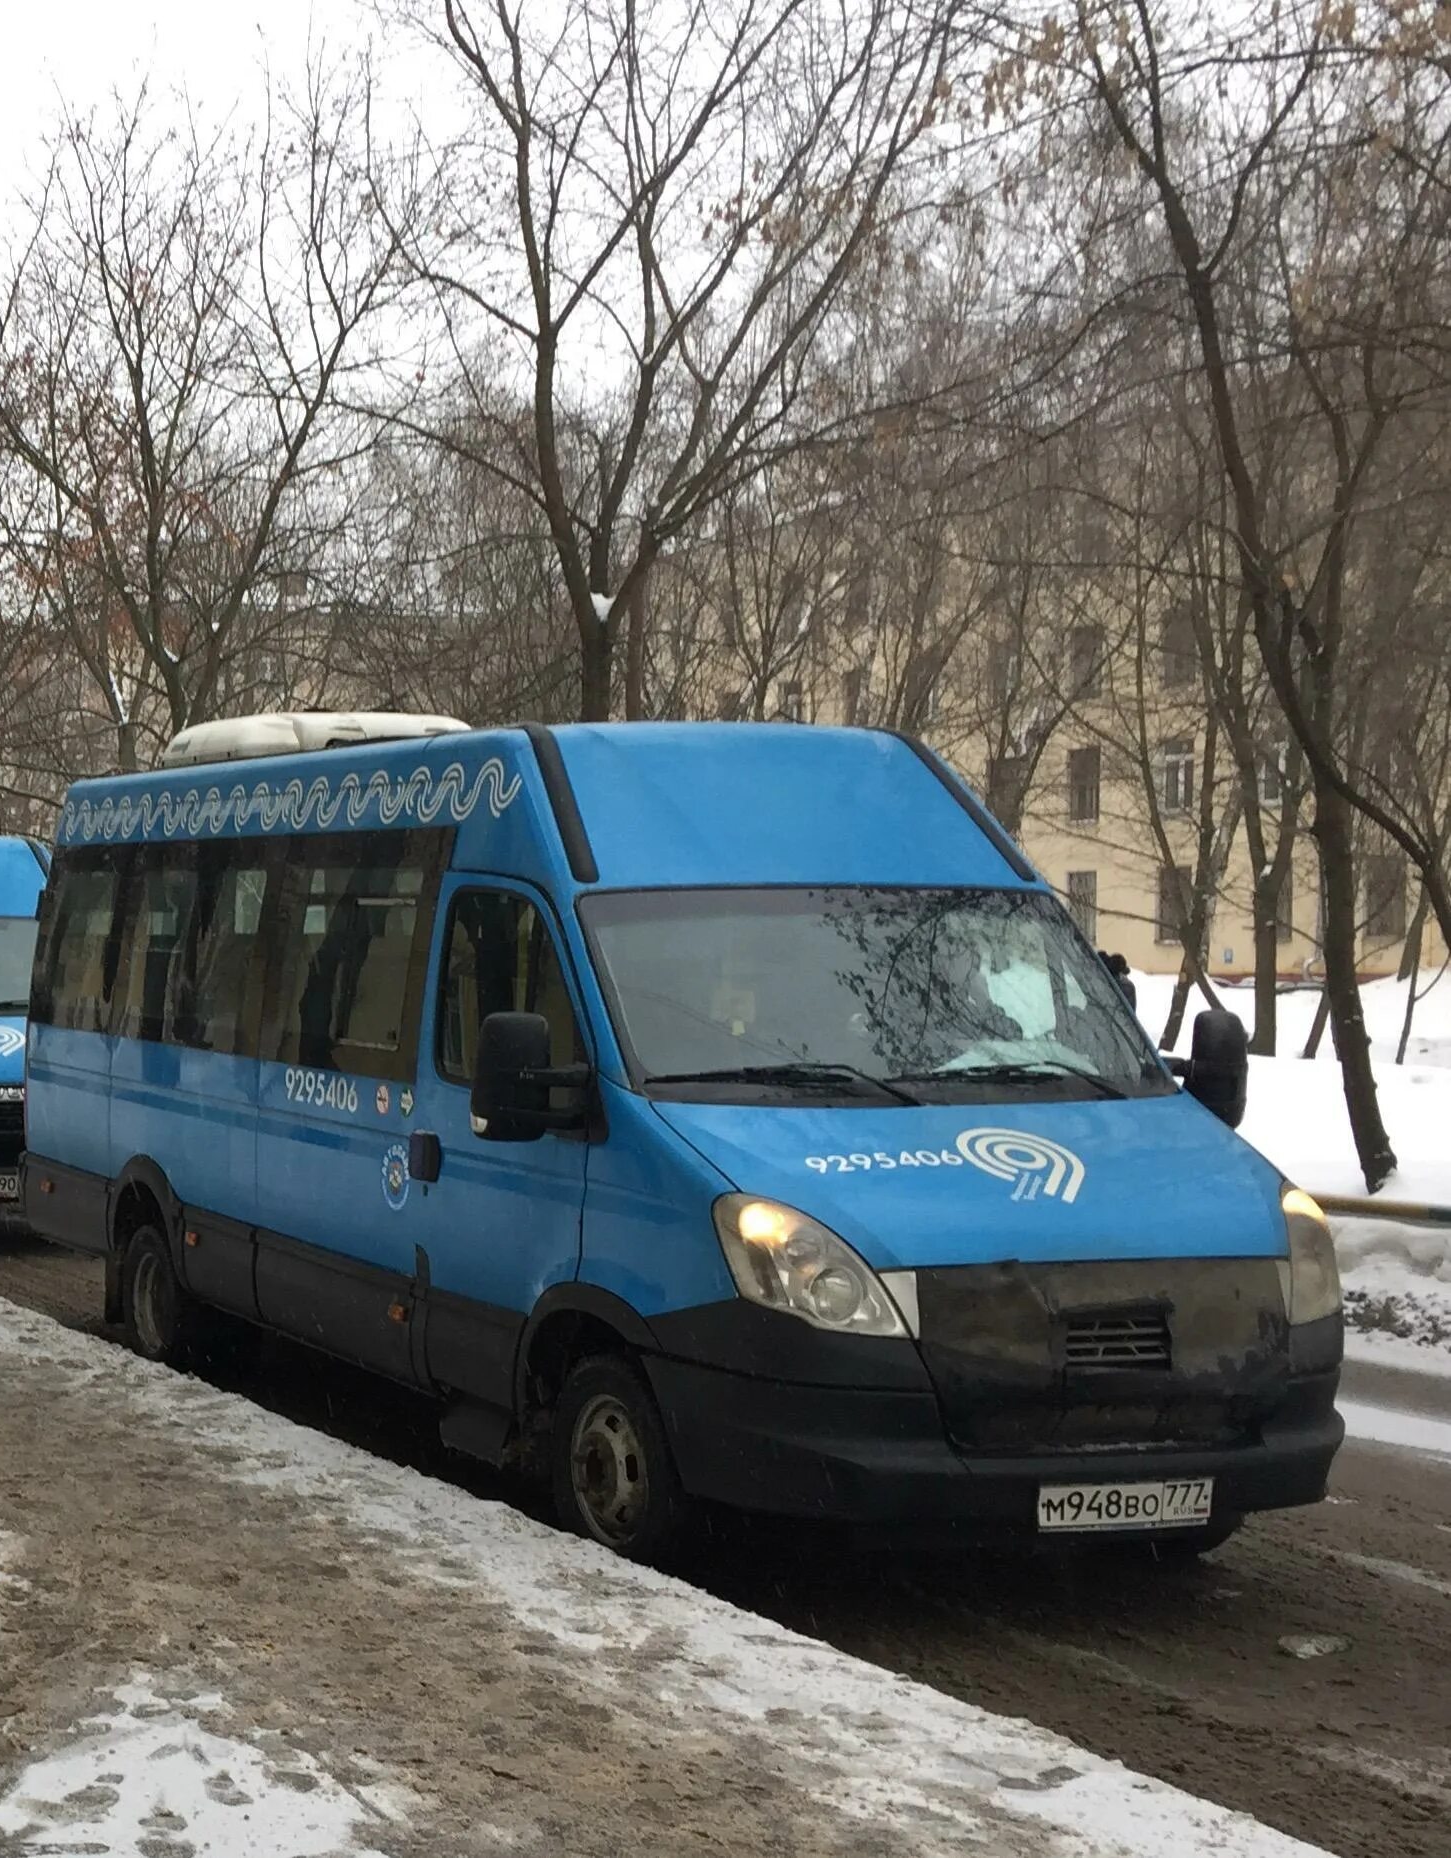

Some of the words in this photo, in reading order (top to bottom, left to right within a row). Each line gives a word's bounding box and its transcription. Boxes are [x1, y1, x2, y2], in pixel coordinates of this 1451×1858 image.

[285, 1067, 358, 1114] 9295406
[805, 1149, 963, 1174] 9295406
[1165, 1482, 1206, 1507] 777
[1173, 1506, 1194, 1515] RUS
